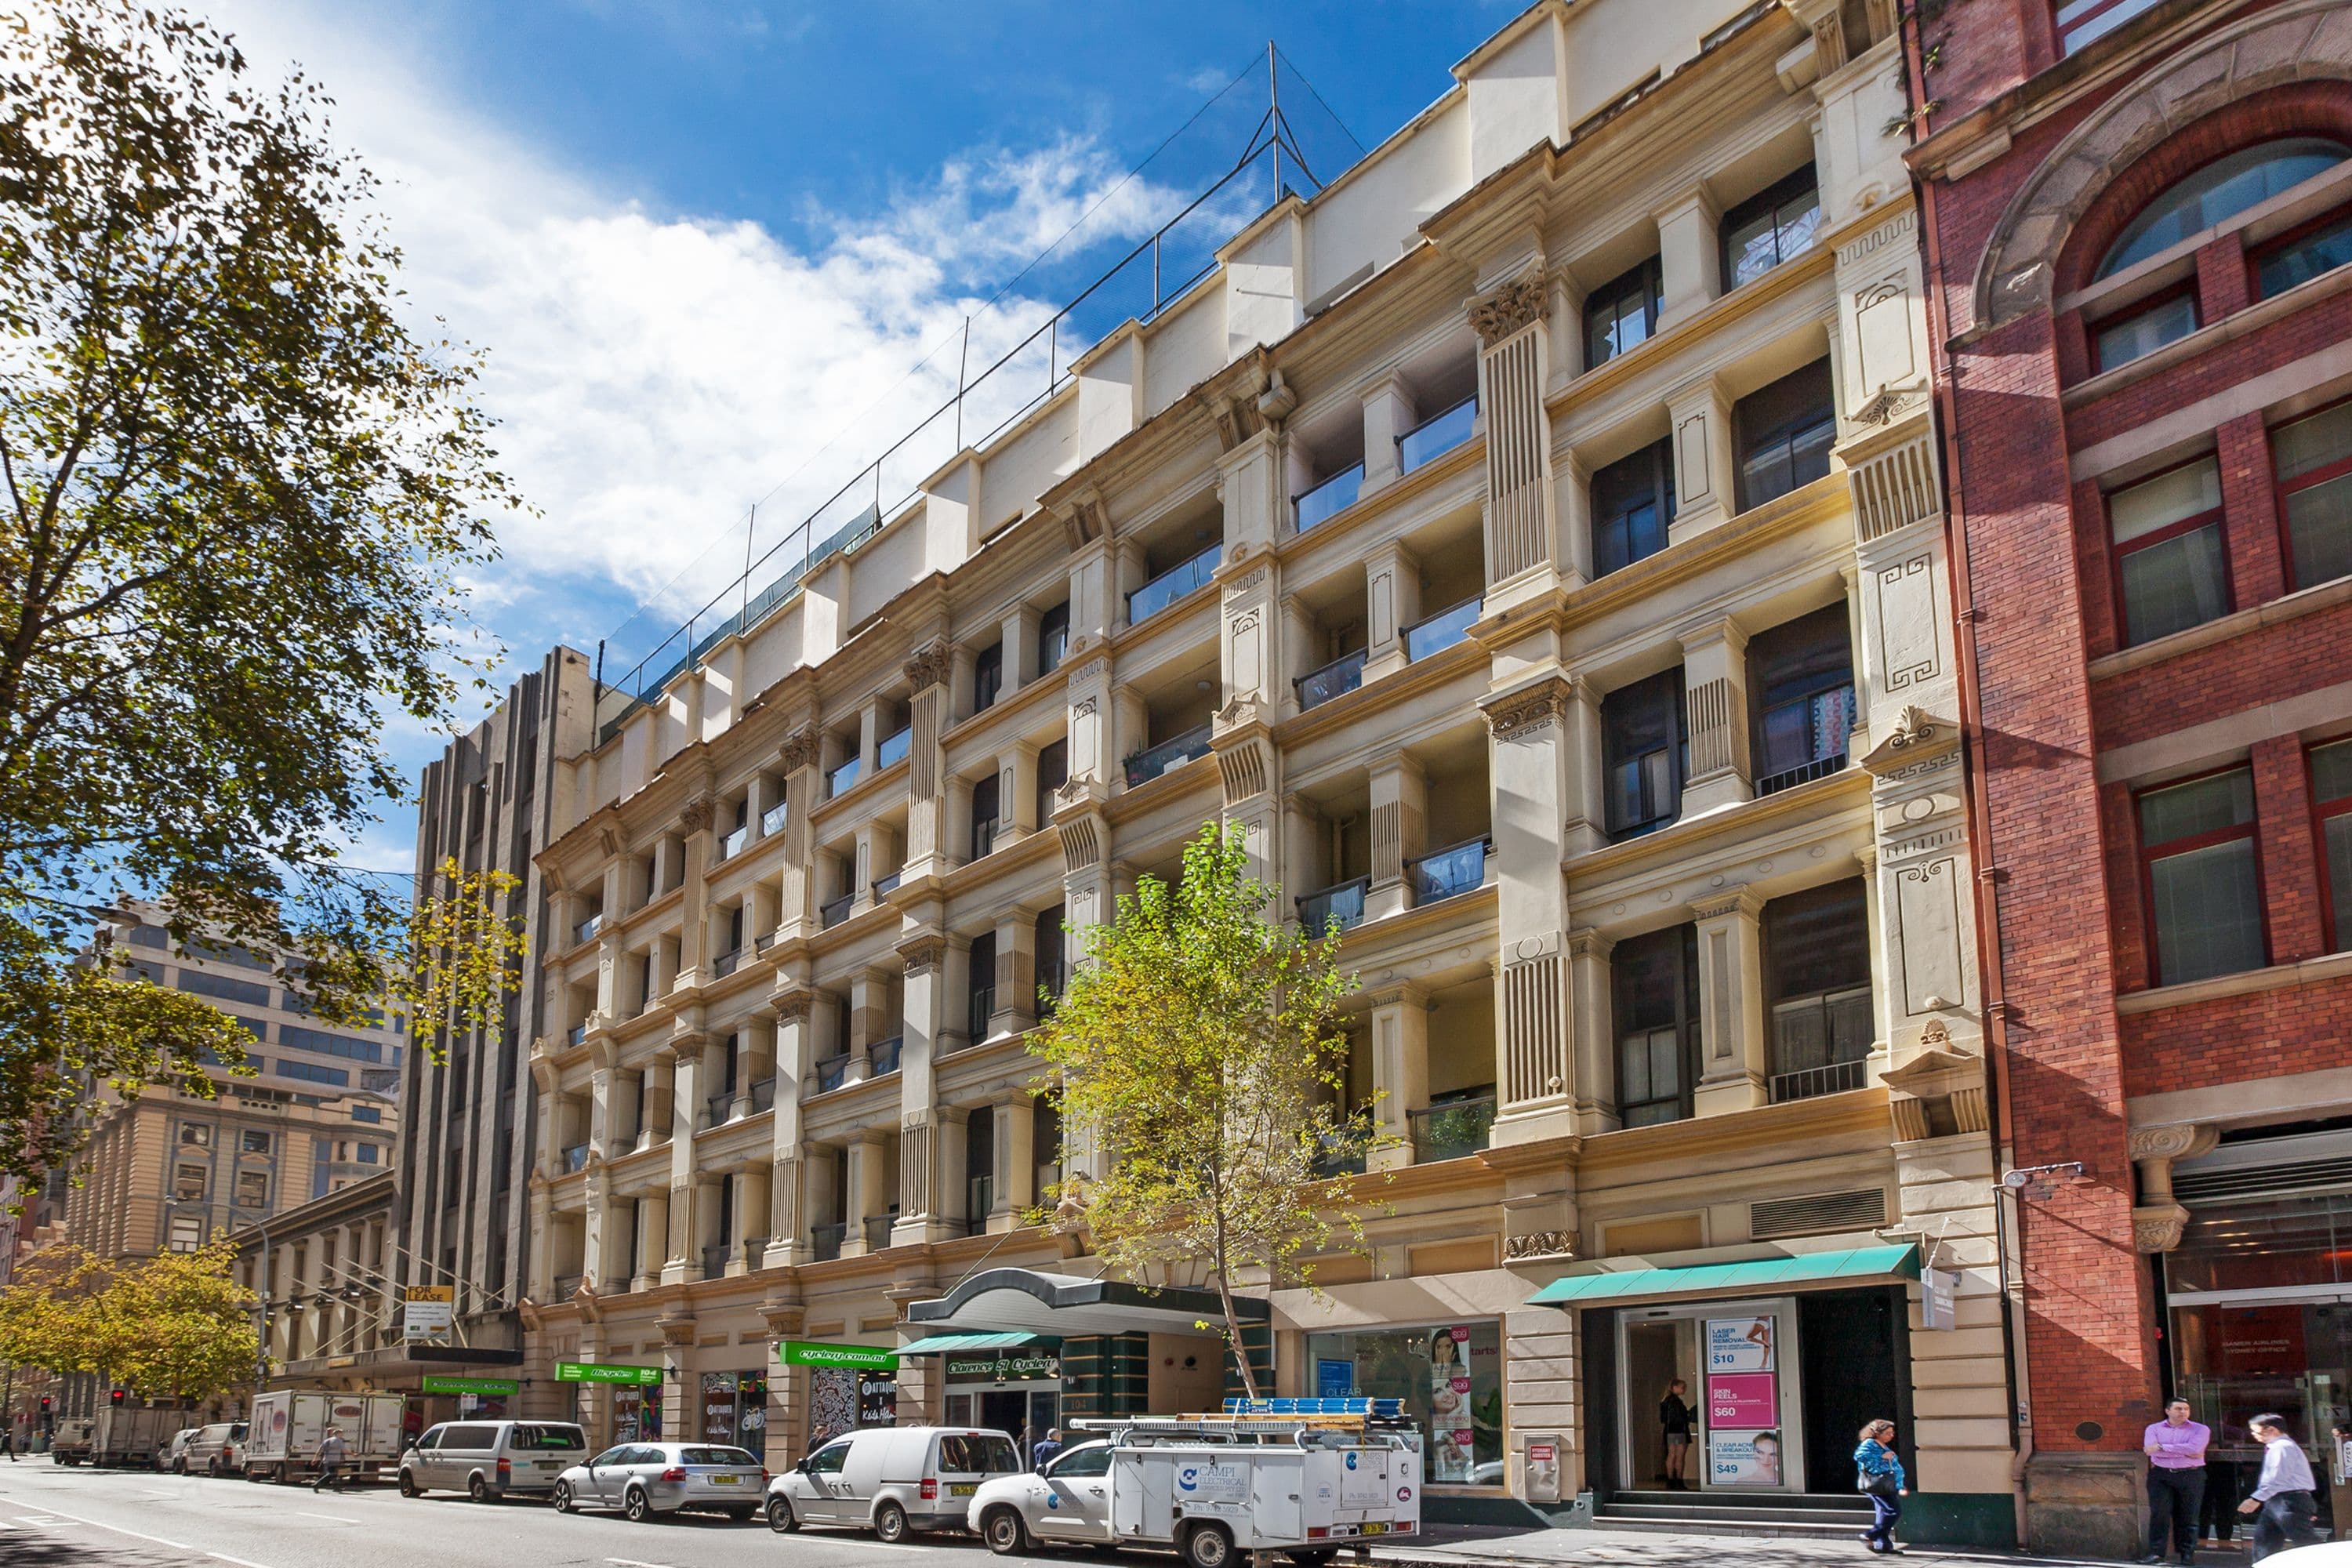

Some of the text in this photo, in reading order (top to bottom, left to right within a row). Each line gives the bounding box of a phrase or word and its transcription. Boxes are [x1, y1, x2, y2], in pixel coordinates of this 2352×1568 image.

[408, 1286, 432, 1294] FOR
[408, 1294, 444, 1302] LEASE
[800, 1349, 887, 1363] cyclery.com.au
[1713, 1354, 1735, 1364] $10
[948, 1357, 1057, 1374] Clarence St Cyclery
[591, 1369, 633, 1378] Bicycles
[872, 1381, 897, 1395] ATTAQUE
[1453, 1381, 1468, 1391] $99
[1326, 1387, 1363, 1398] CLEAR
[1714, 1406, 1736, 1417] $60
[1455, 1432, 1471, 1443] $10
[1199, 1466, 1235, 1477] CAMPI
[1716, 1464, 1738, 1474] $49
[1199, 1477, 1246, 1486] ELECTRICAL
